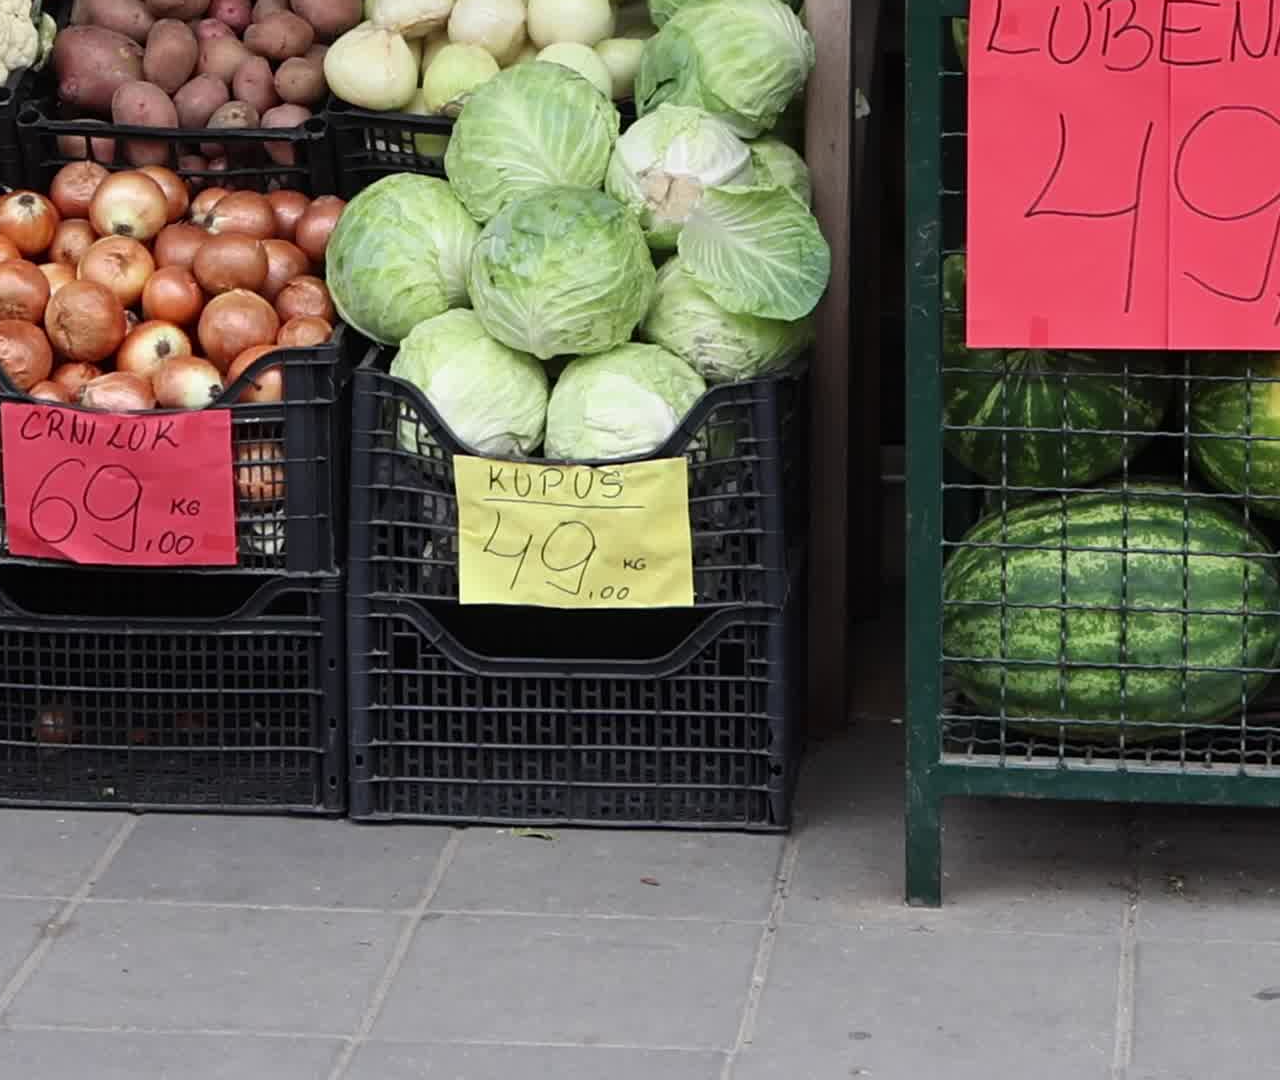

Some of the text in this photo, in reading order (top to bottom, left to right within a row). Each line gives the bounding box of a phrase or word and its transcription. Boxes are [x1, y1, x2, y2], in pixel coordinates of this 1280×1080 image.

[20, 409, 179, 452] CRNI LUK
[488, 465, 624, 499] KUPUS
[170, 498, 200, 516] KG
[623, 558, 646, 570] KG
